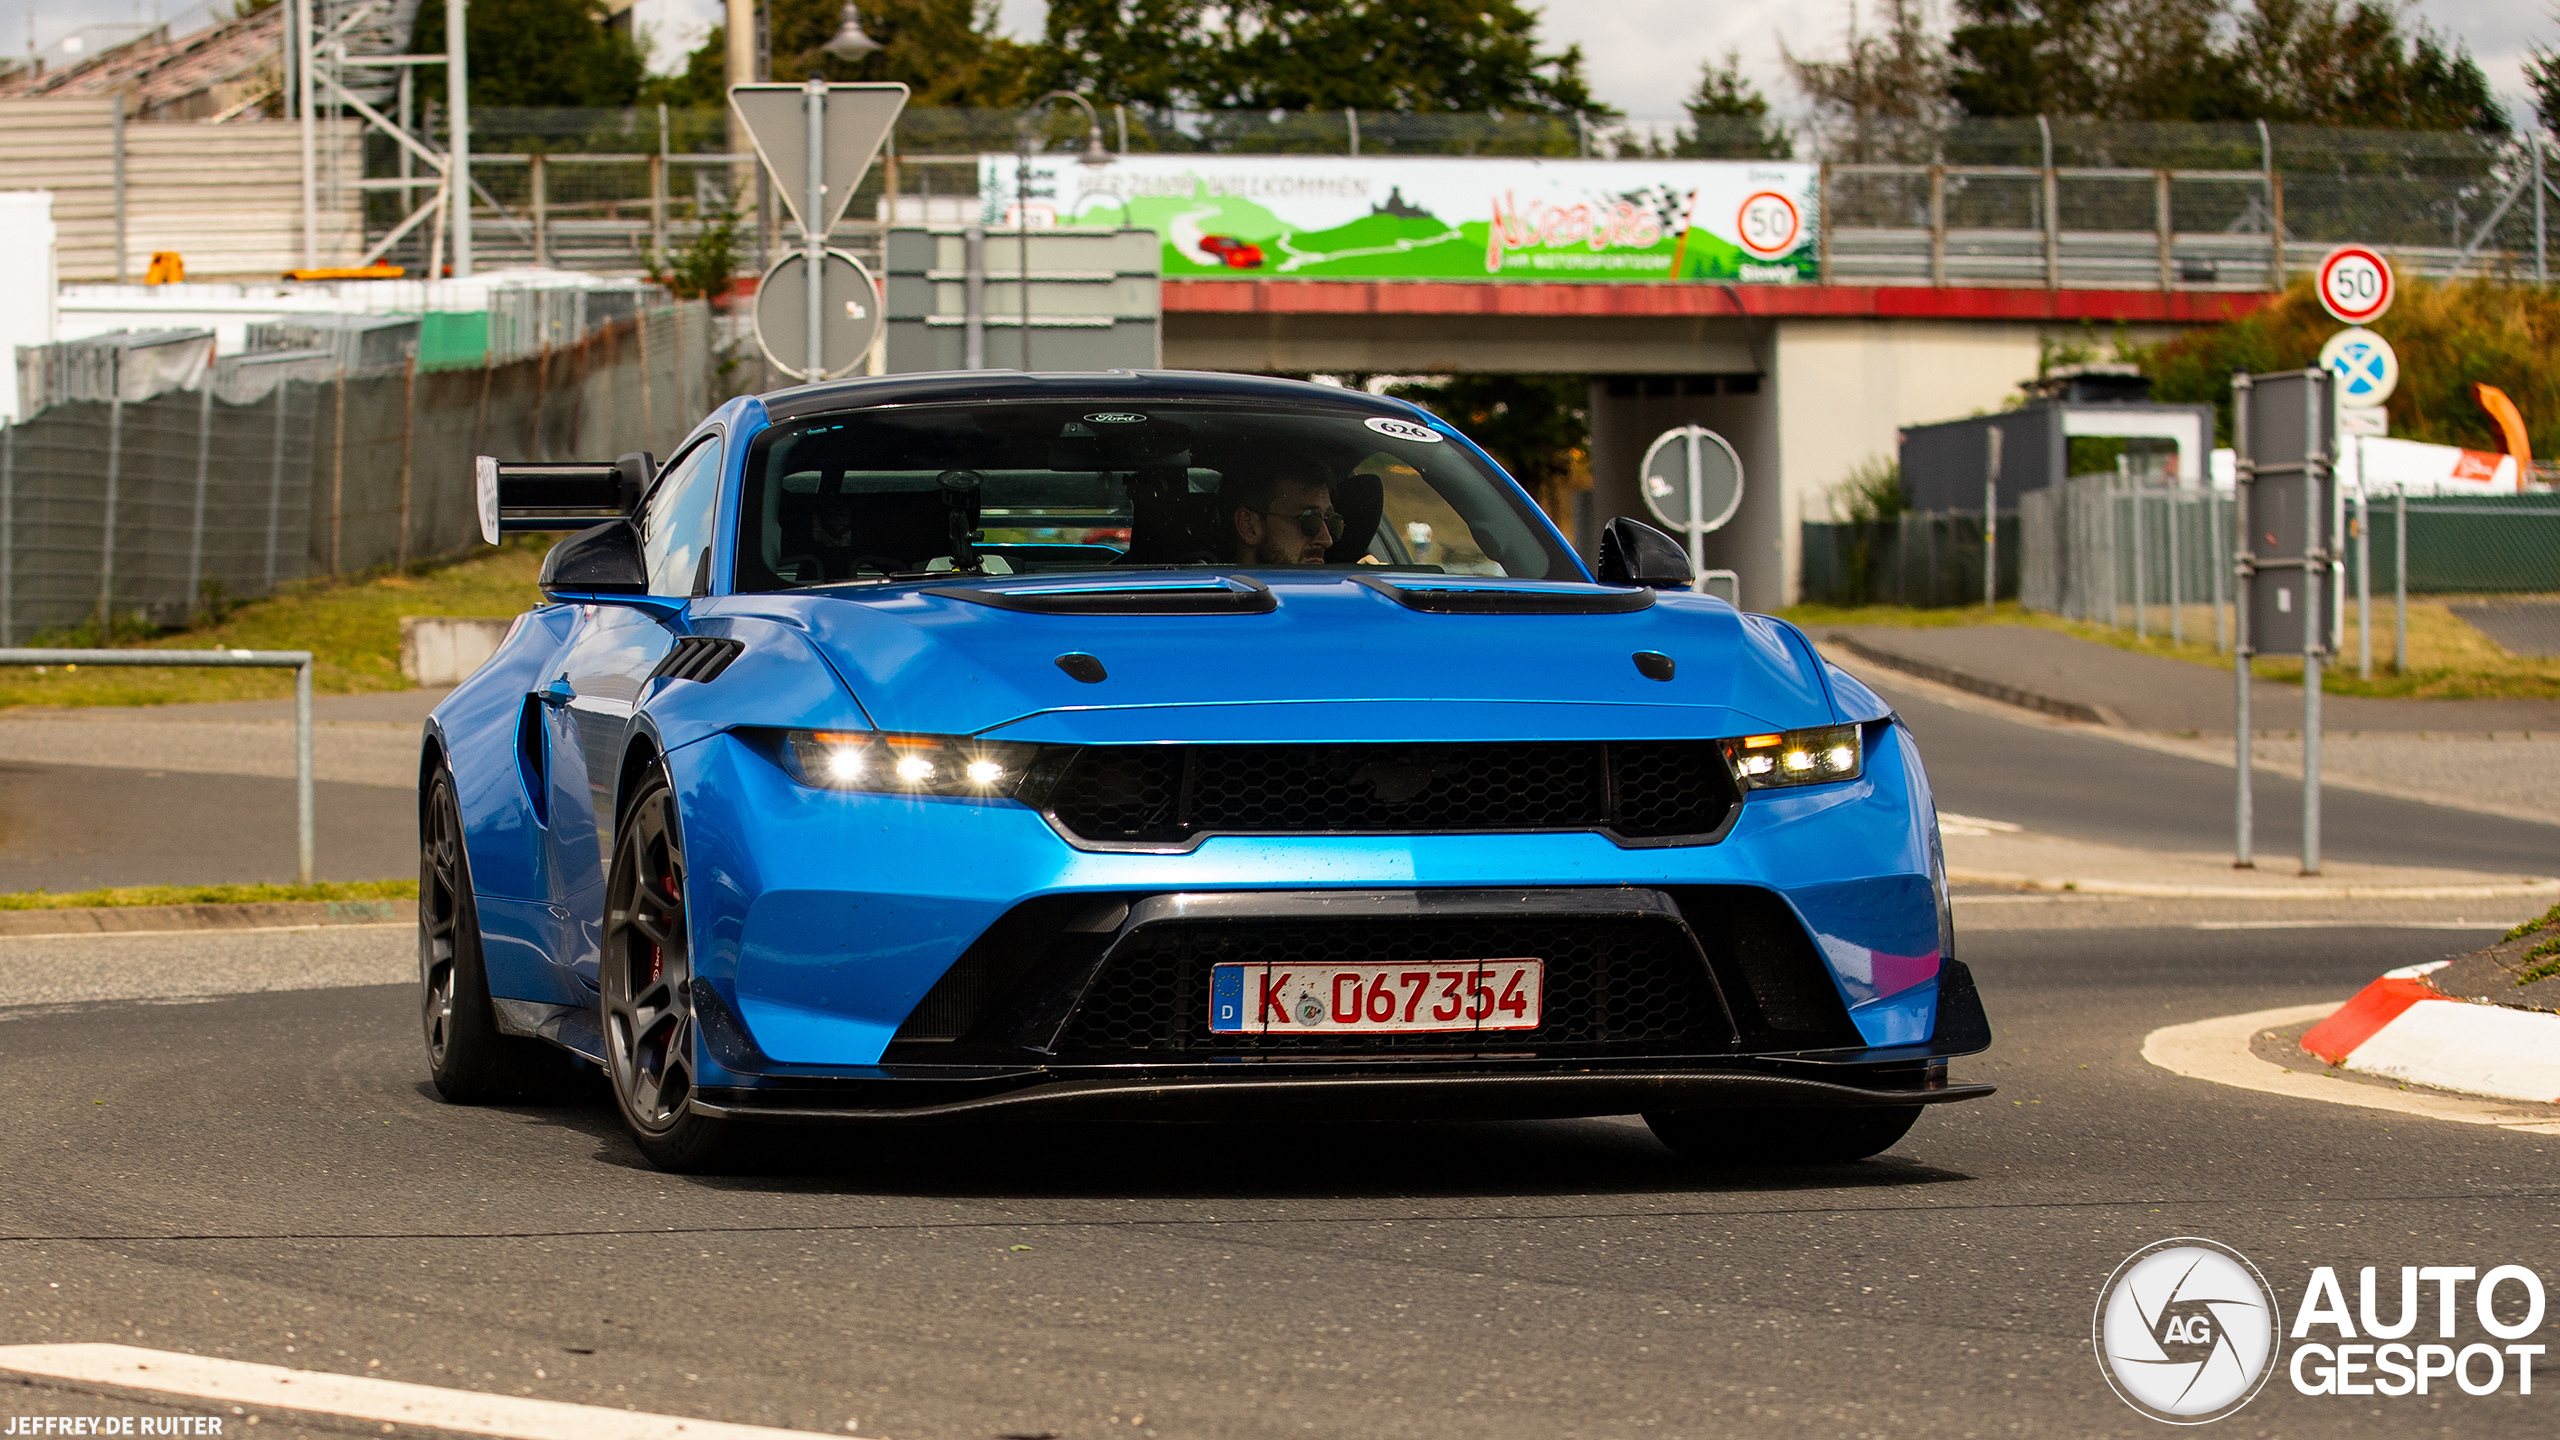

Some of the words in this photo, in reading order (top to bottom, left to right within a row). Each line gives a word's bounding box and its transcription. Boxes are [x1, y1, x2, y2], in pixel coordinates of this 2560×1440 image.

[1207, 174, 1370, 198] WILLKOMMEN
[1751, 207, 1787, 236] 50
[2338, 269, 2375, 298] 50
[1095, 412, 1136, 422] Ford
[1381, 423, 1427, 437] 626
[1258, 973, 1292, 1024] K
[1331, 969, 1527, 1024] 067354
[1222, 1005, 1233, 1019] D
